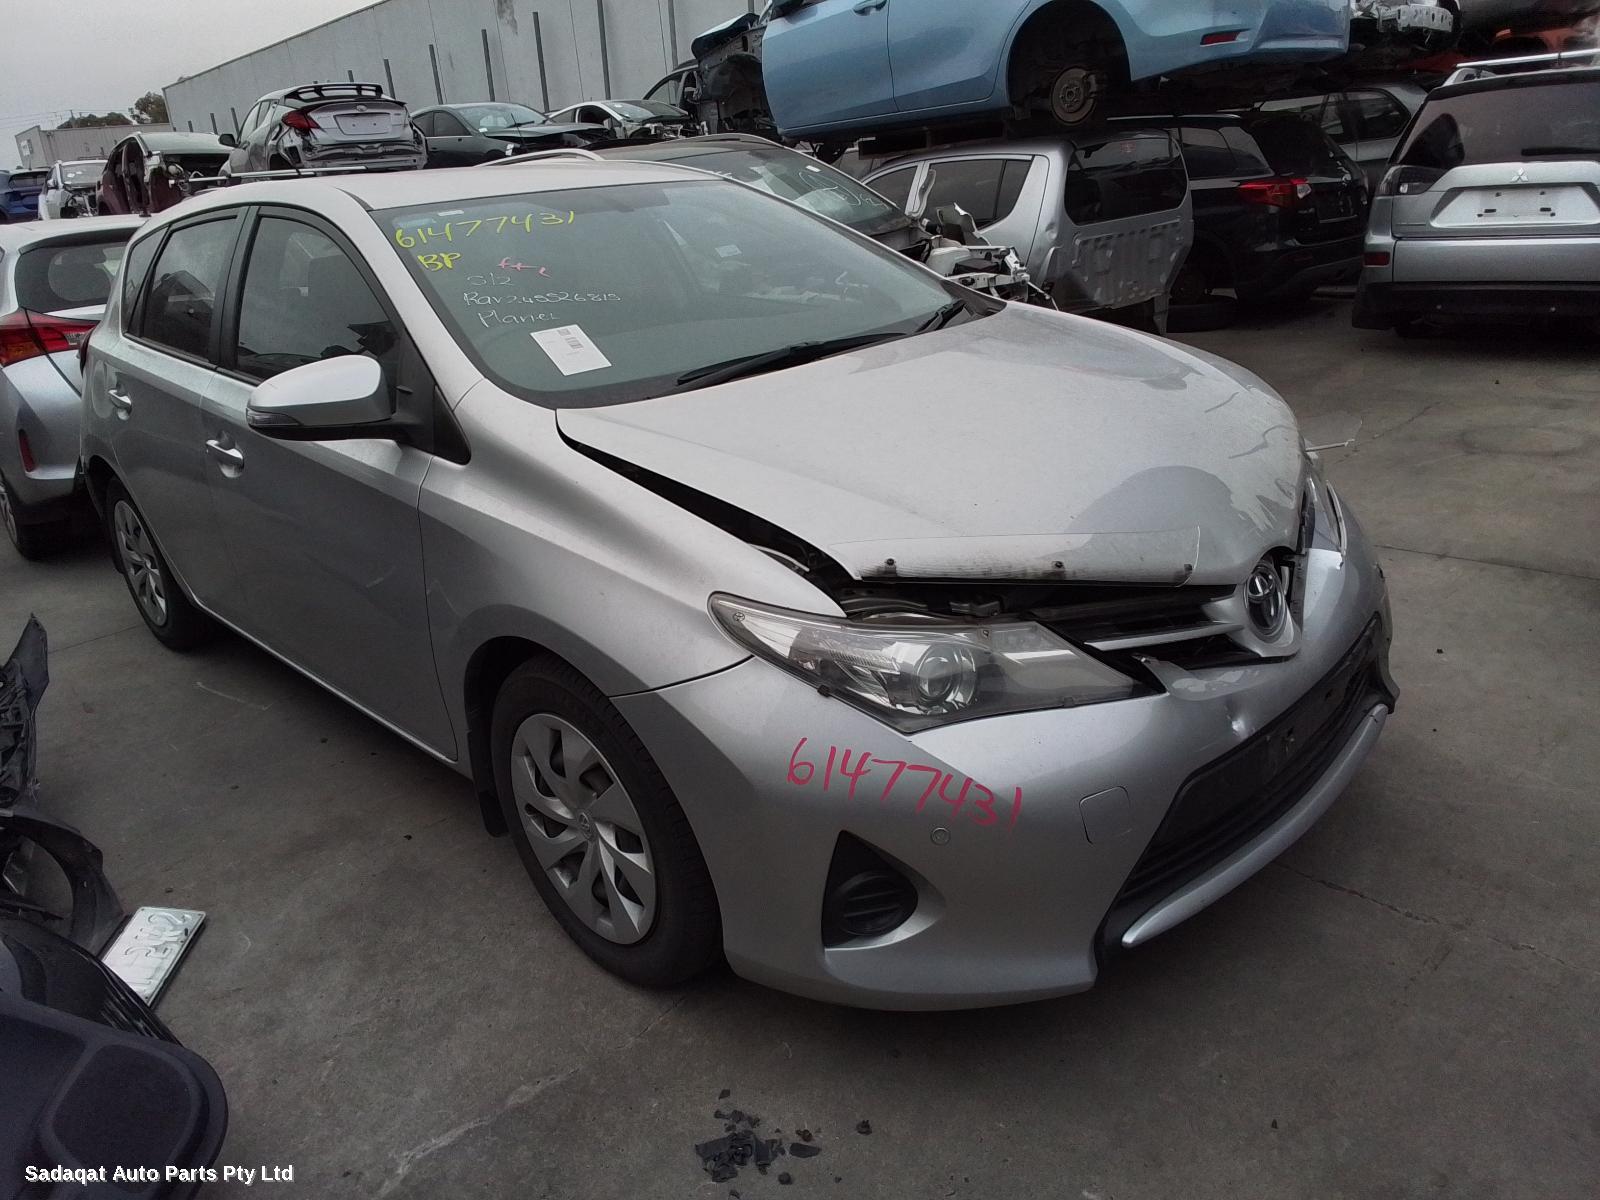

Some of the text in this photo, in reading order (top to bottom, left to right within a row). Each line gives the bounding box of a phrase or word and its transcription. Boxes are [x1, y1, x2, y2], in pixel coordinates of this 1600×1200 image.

[394, 210, 576, 248] 61477431
[417, 251, 461, 272] BP
[786, 737, 1023, 832] 61477431
